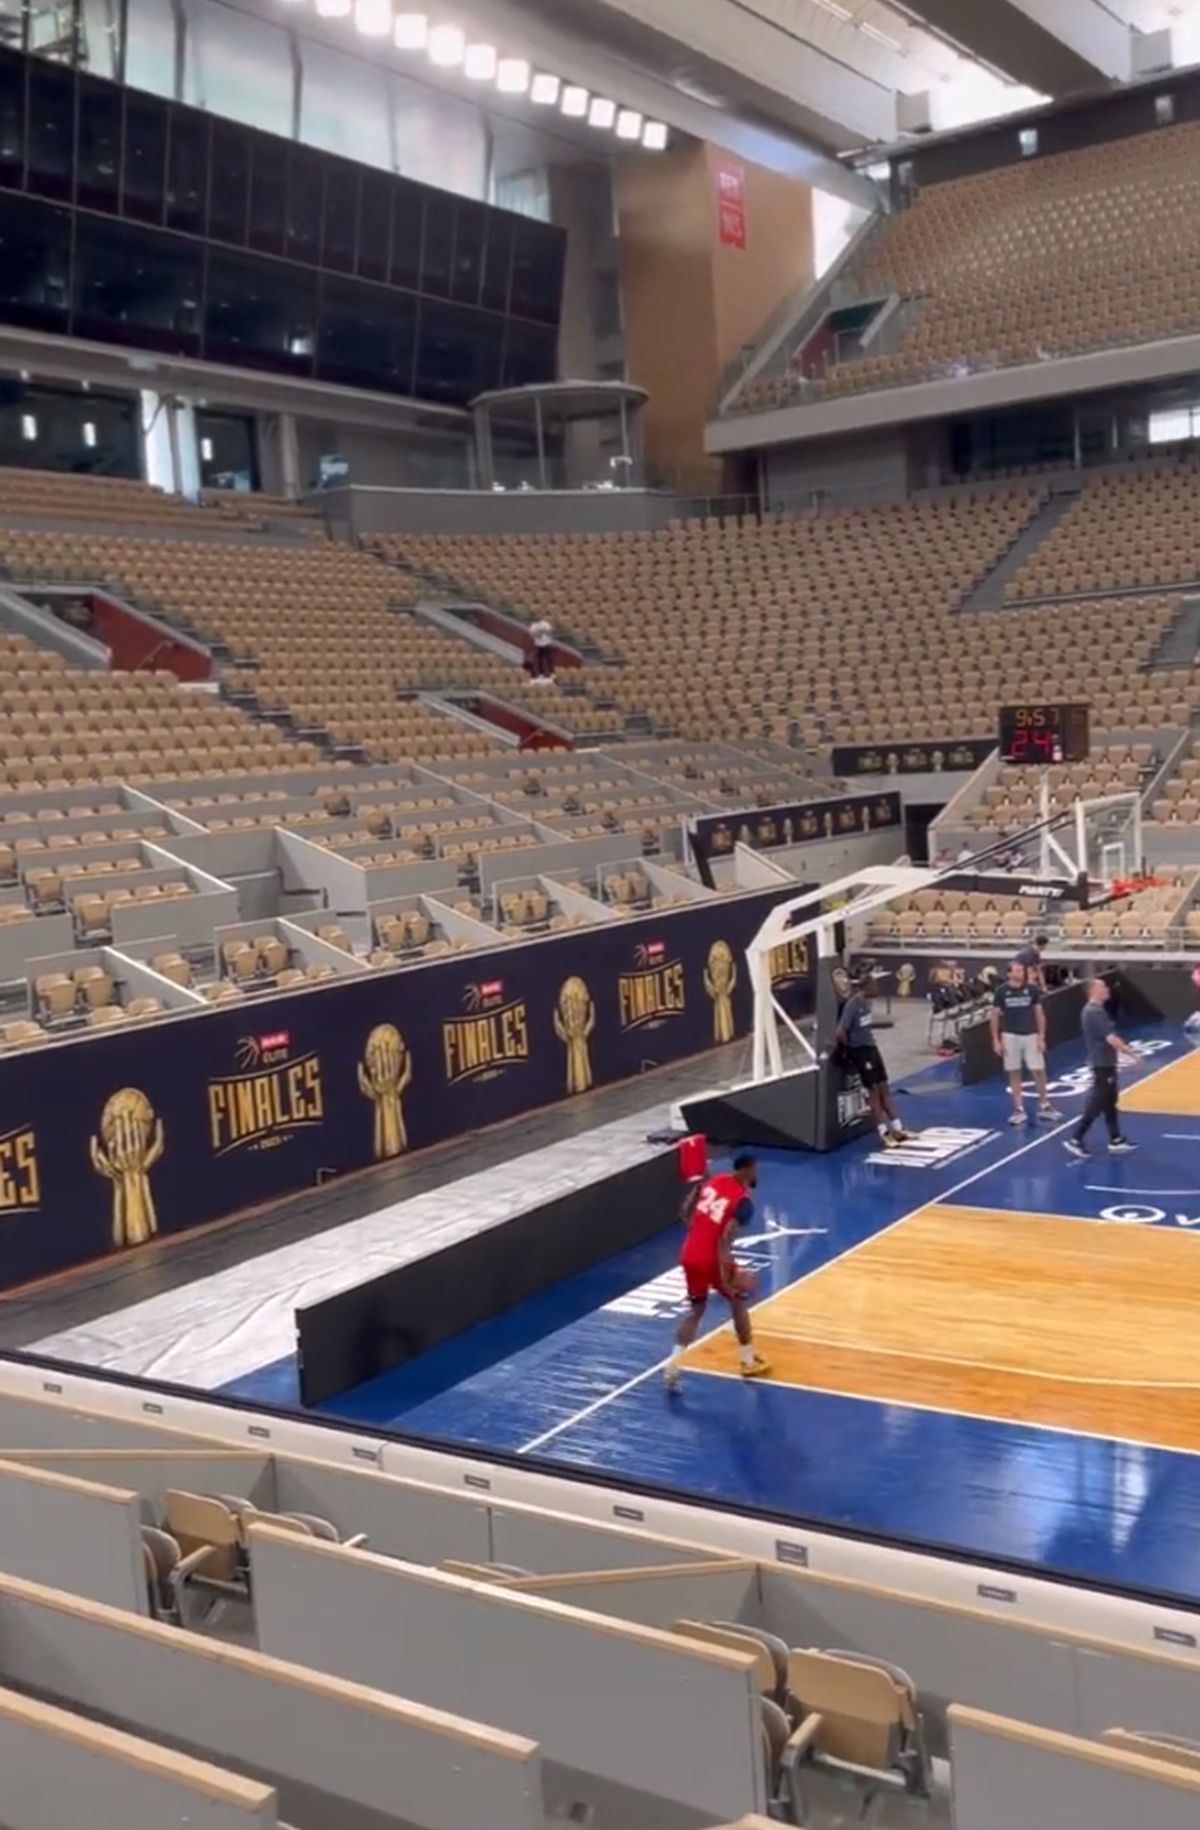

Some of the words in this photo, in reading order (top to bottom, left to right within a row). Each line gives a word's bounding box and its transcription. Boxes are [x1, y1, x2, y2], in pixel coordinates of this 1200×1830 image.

[1011, 730, 1053, 757] 24
[443, 1004, 528, 1079] FINALES
[208, 1057, 323, 1149] FINALES
[697, 1186, 729, 1224] 24
